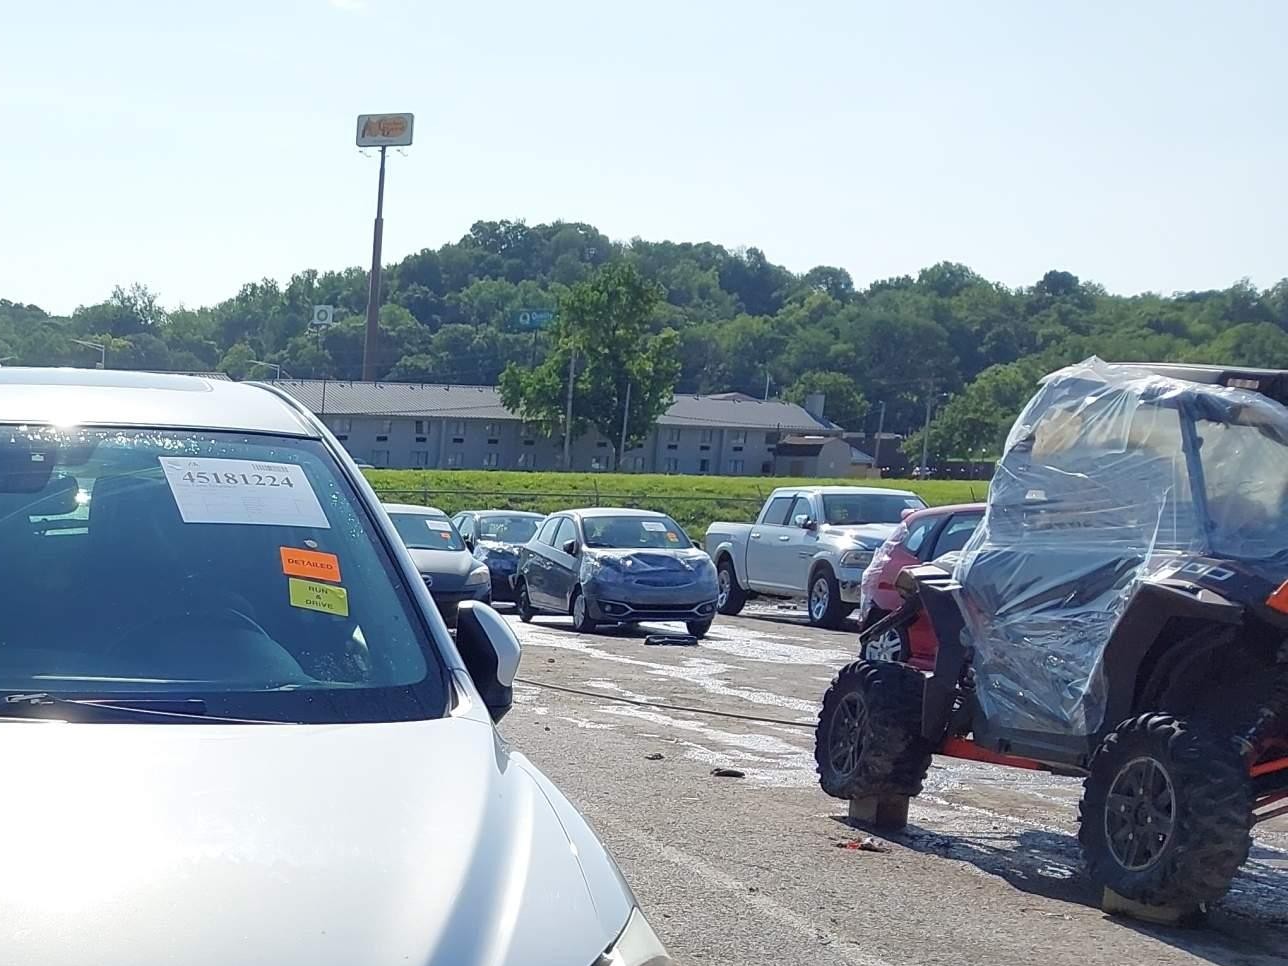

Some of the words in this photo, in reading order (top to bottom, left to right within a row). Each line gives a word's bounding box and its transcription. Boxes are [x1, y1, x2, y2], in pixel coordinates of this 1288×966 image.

[182, 471, 294, 488] 45181224
[287, 558, 333, 570] DETAILED
[308, 585, 328, 594] RUN
[305, 599, 335, 610] DRIVE
